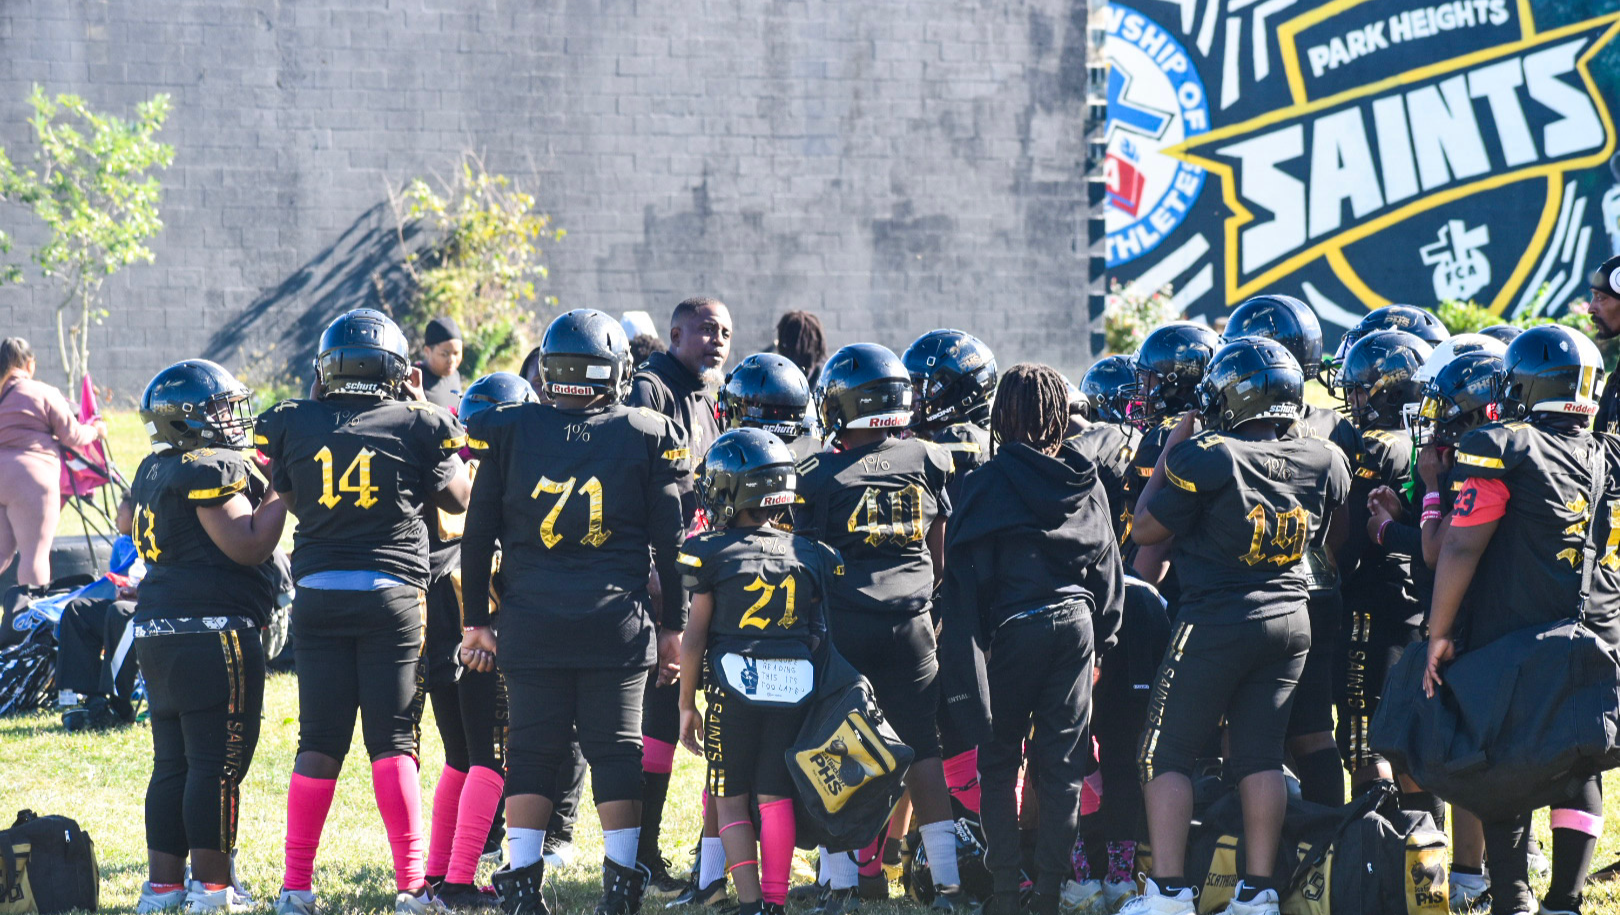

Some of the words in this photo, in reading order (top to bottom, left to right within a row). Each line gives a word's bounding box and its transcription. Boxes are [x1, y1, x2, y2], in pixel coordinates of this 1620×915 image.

[1307, 29, 1387, 77] PARK
[1388, 0, 1511, 44] HEIGHTS
[1178, 82, 1206, 130] OF
[1216, 37, 1605, 274] SAINTS
[345, 381, 378, 391] schutt
[554, 384, 593, 395] Riddell
[563, 423, 591, 443] 1%
[313, 445, 380, 510] 14
[858, 453, 891, 474] 1%
[1263, 457, 1293, 480] 1%
[531, 475, 612, 549] 71
[847, 483, 925, 548] 40
[1239, 504, 1309, 567] 19
[756, 536, 787, 555] 1%
[739, 574, 798, 630] 21
[411, 664, 427, 722] SAINTS
[761, 671, 778, 681] THIS
[761, 680, 776, 691] TOO
[1150, 667, 1175, 727] SAINTS
[1347, 650, 1366, 709] SAINTS
[225, 719, 244, 778] SAINTS
[707, 702, 723, 762] SAINTS
[809, 752, 842, 796] PHS
[1415, 891, 1444, 906] PHS
